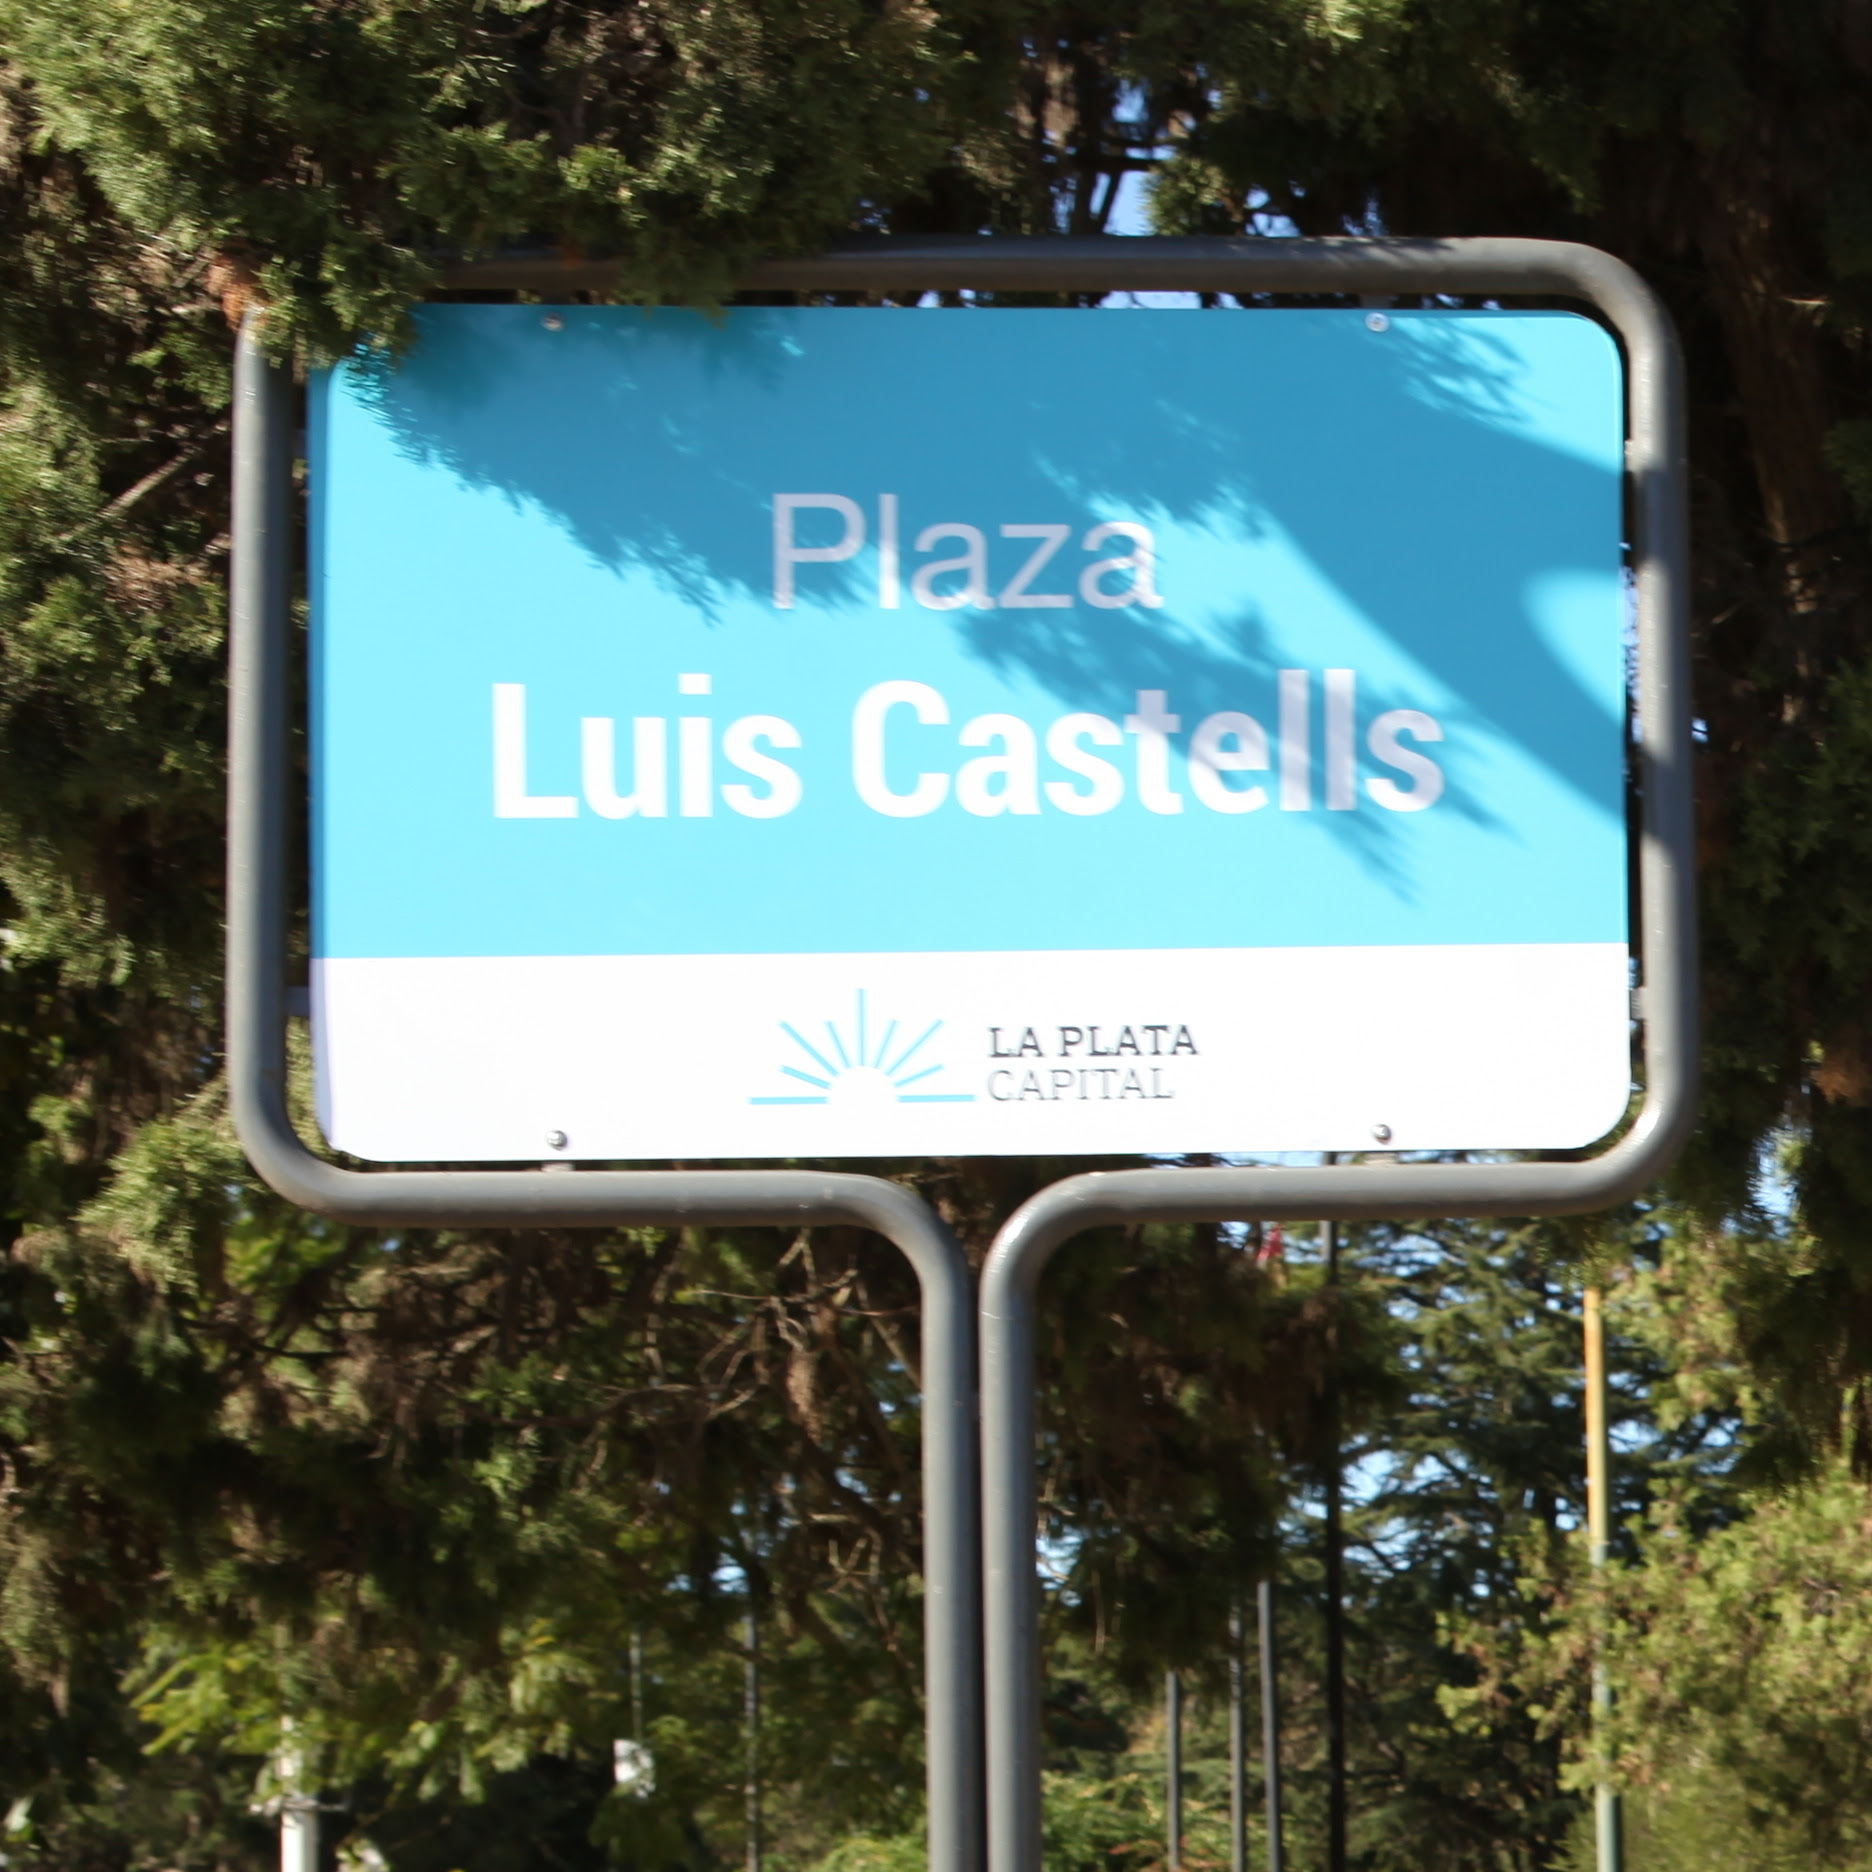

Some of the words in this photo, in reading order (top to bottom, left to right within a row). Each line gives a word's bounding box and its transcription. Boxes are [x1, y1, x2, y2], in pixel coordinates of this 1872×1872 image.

[772, 492, 1164, 611] Plaza
[491, 672, 805, 820] Luis
[852, 667, 1446, 818] Castells
[988, 1026, 1045, 1058] LA
[1057, 1024, 1199, 1057] PLATA
[987, 1067, 1175, 1101] CAPITAL
